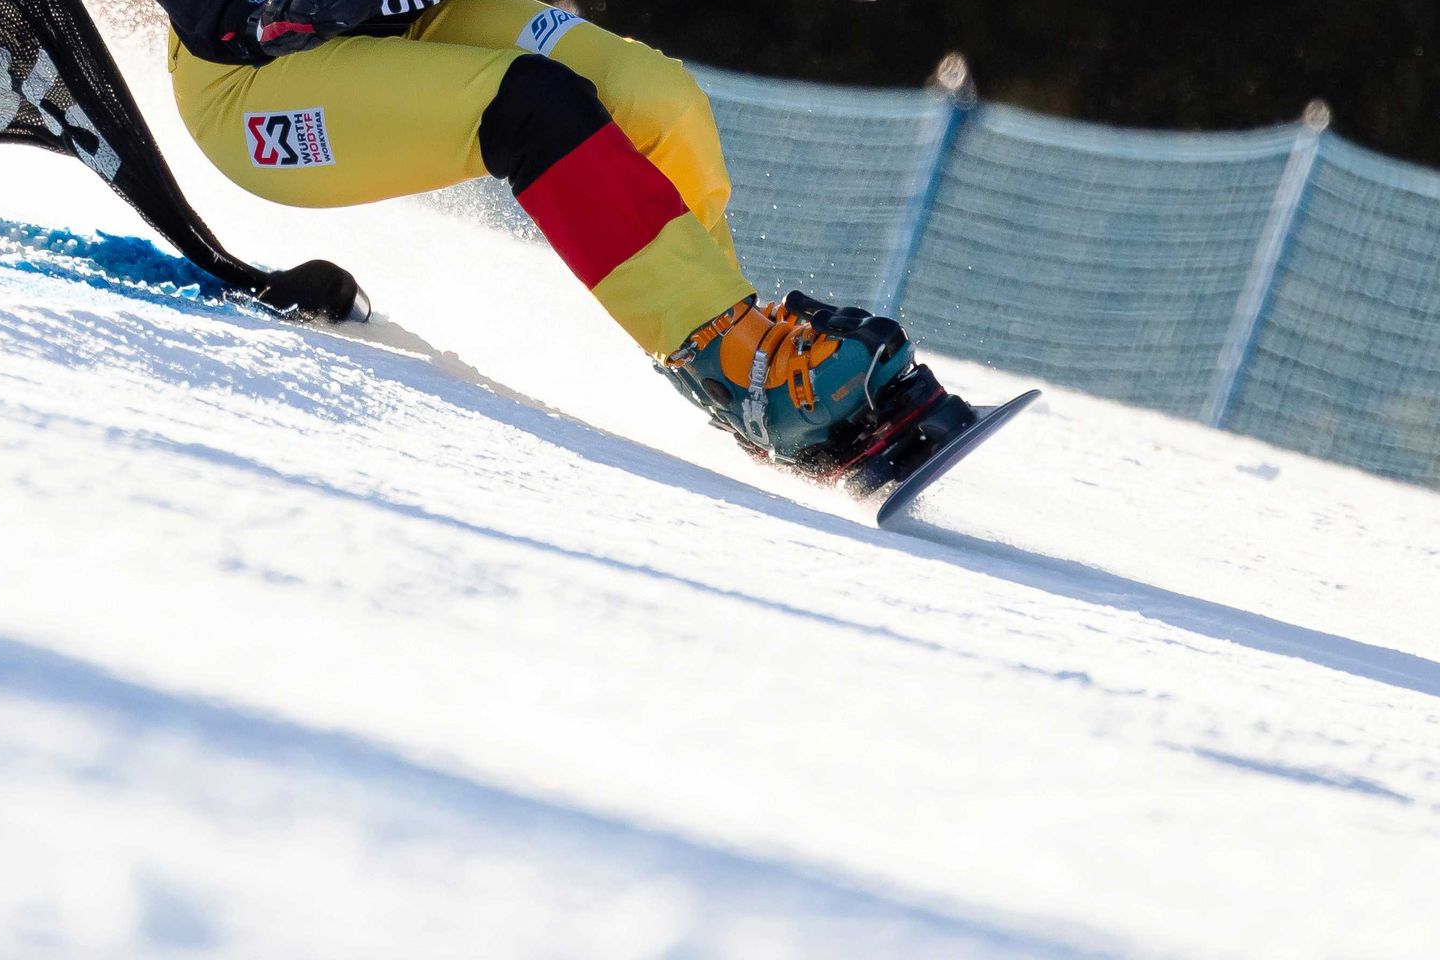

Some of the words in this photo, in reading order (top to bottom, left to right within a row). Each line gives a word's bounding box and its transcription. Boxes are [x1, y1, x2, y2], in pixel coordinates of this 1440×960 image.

[293, 113, 313, 165] WÜRTH
[303, 113, 323, 163] MODYF
[315, 111, 331, 162] WORKWEAR
